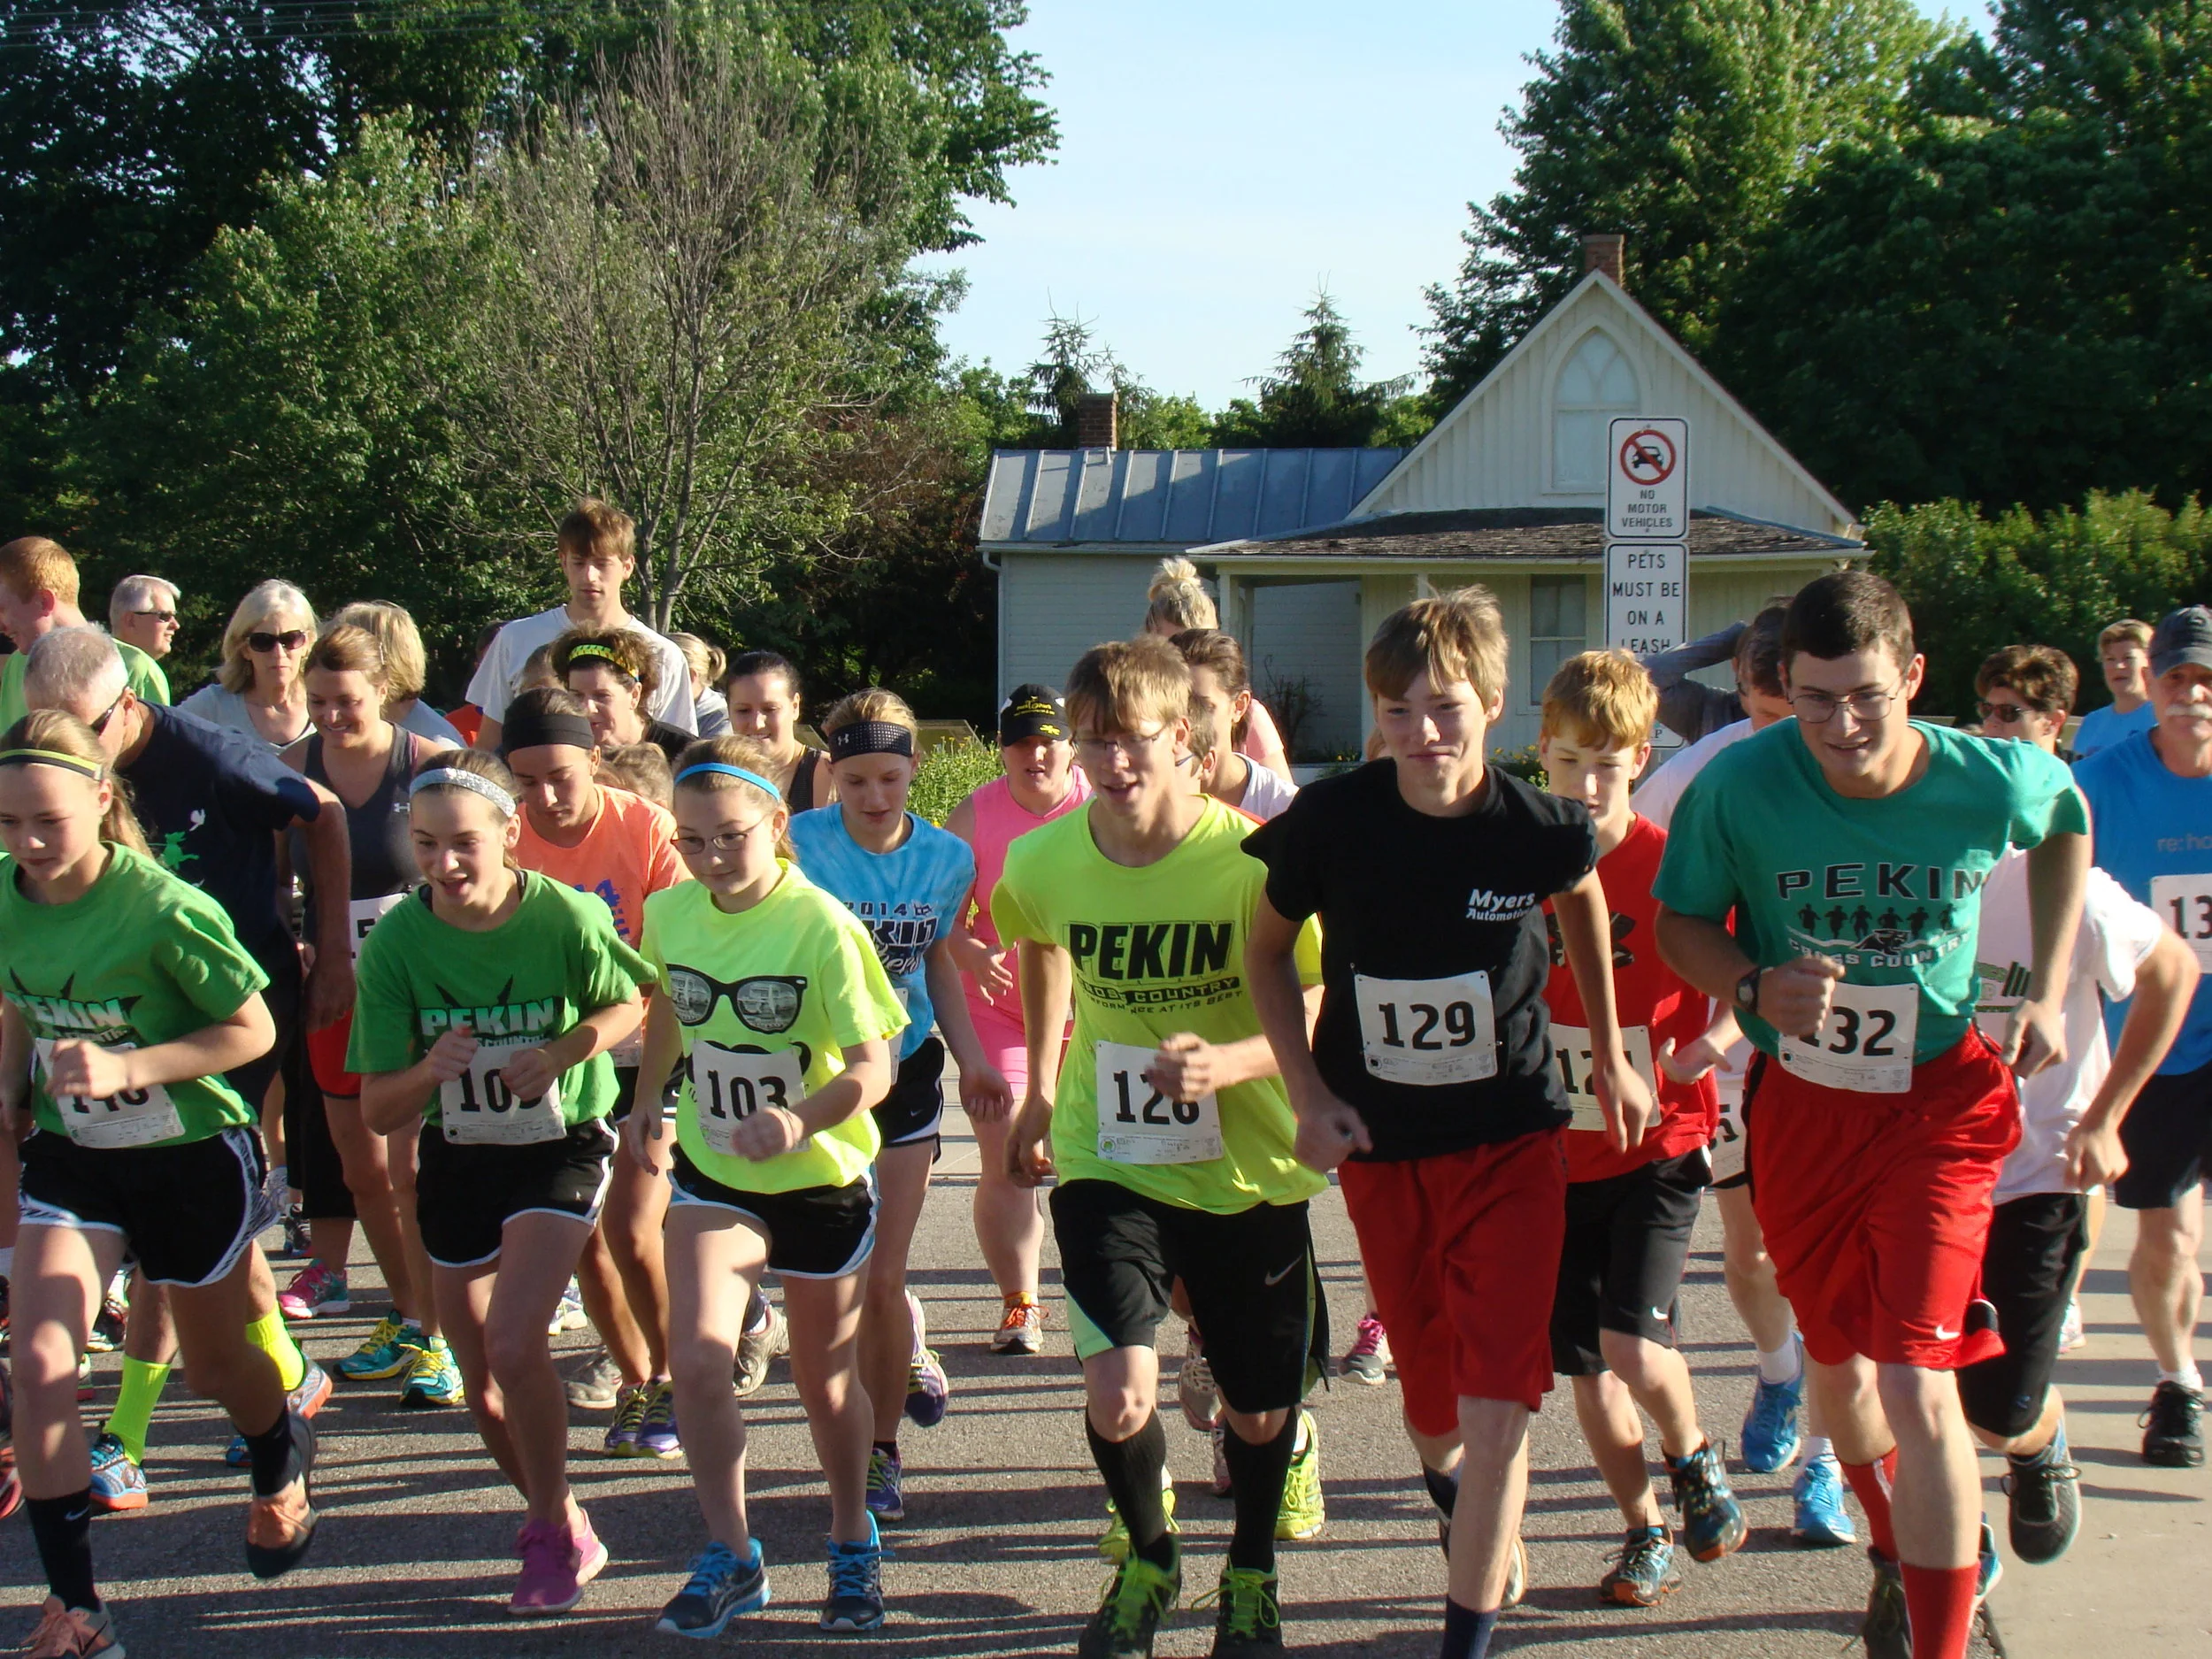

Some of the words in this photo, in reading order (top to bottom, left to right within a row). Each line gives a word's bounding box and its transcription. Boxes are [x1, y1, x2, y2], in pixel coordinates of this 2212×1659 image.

[1640, 489, 1655, 500] NO
[1627, 503, 1667, 514] MOTOR
[1621, 517, 1674, 528] VEHICLES
[1628, 553, 1666, 569] PETS
[1612, 581, 1654, 597] MUST
[1661, 581, 1680, 597] BE
[1627, 610, 1647, 626] ON
[1655, 610, 1664, 626] A
[1776, 862, 1983, 901] PEKIN
[1468, 887, 1535, 912] Myers
[1069, 922, 1233, 980] PEKIN
[1133, 979, 1235, 1003] COUNTRY
[1158, 1003, 1176, 1013] AT
[1179, 1000, 1202, 1010] ITS
[1206, 990, 1243, 1005] BEST
[420, 997, 555, 1036] PEKIN
[1378, 1001, 1476, 1050] 129
[459, 1068, 543, 1113] 10
[708, 1070, 788, 1121] 103
